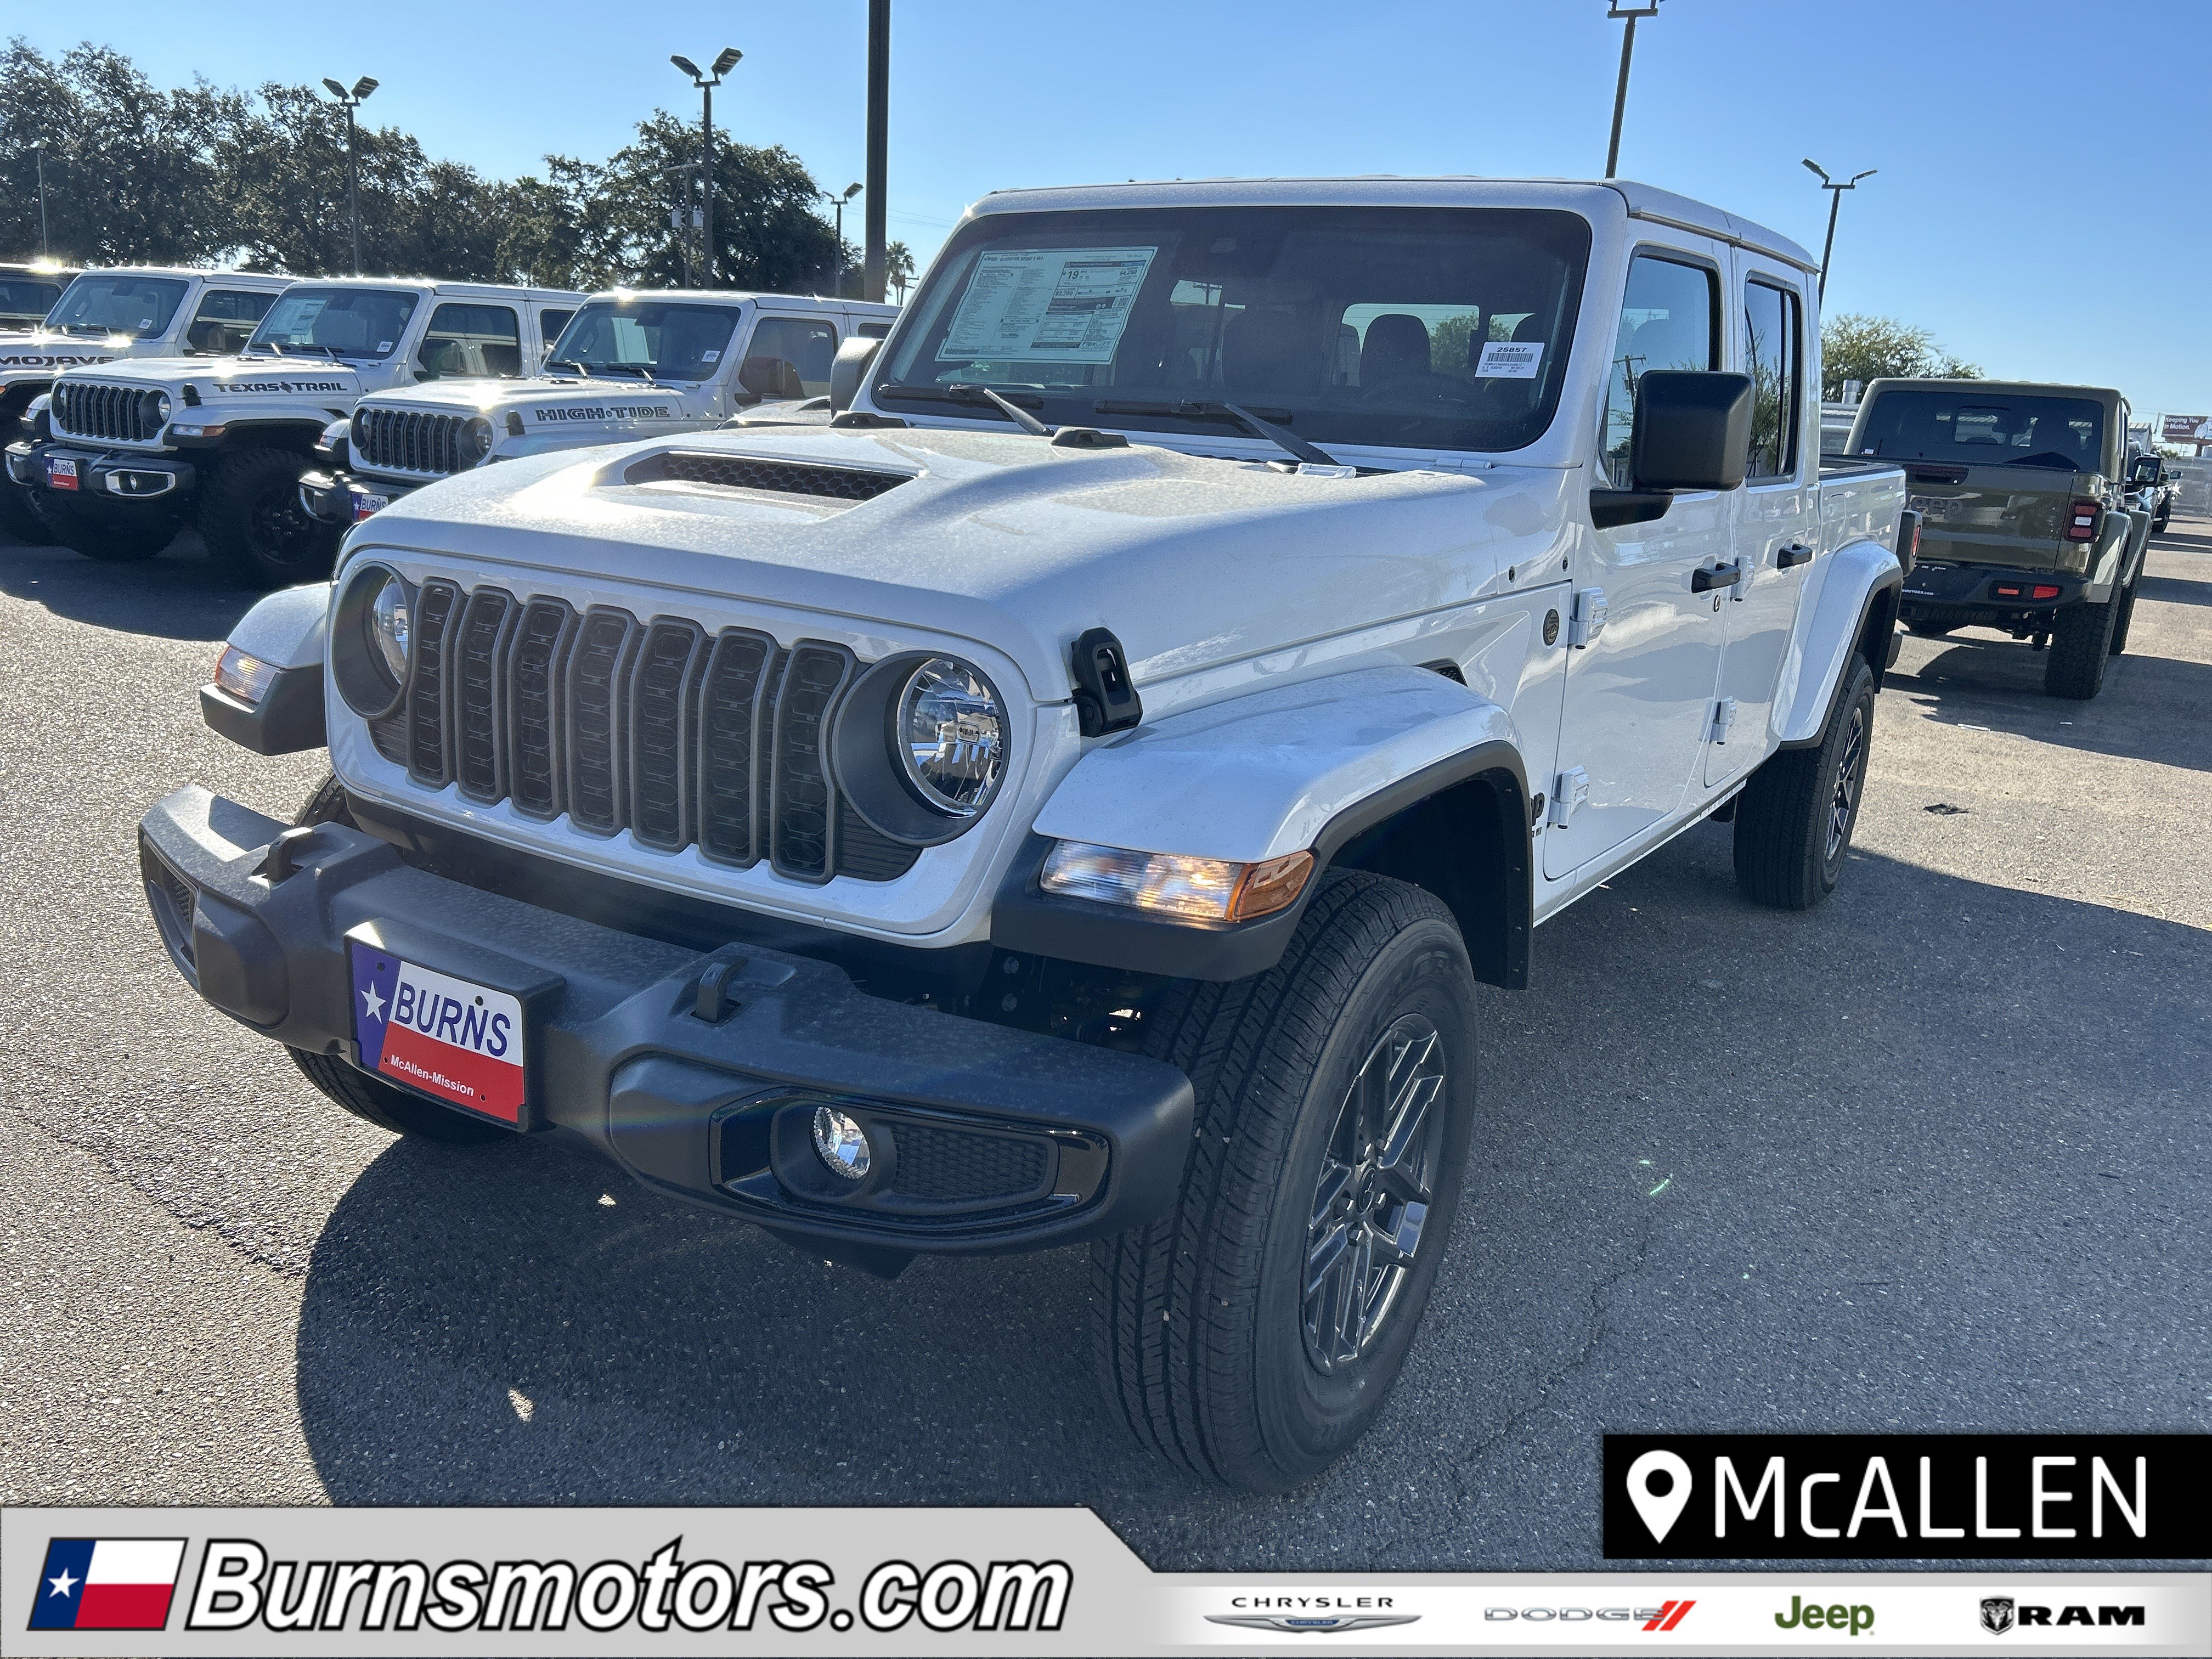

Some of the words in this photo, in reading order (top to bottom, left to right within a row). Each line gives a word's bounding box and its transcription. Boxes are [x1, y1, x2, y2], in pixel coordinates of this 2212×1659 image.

[1068, 270, 1079, 280] 19
[0, 356, 115, 366] MOJAVE
[212, 383, 280, 393] TEXAS
[291, 382, 348, 392] TRAIL
[535, 408, 605, 421] HIGH
[610, 407, 670, 419] TIDE
[54, 463, 75, 476] BURNS
[1910, 498, 1964, 516] eep
[394, 981, 511, 1057] BURNS
[391, 1054, 475, 1097] McAllen-Mission
